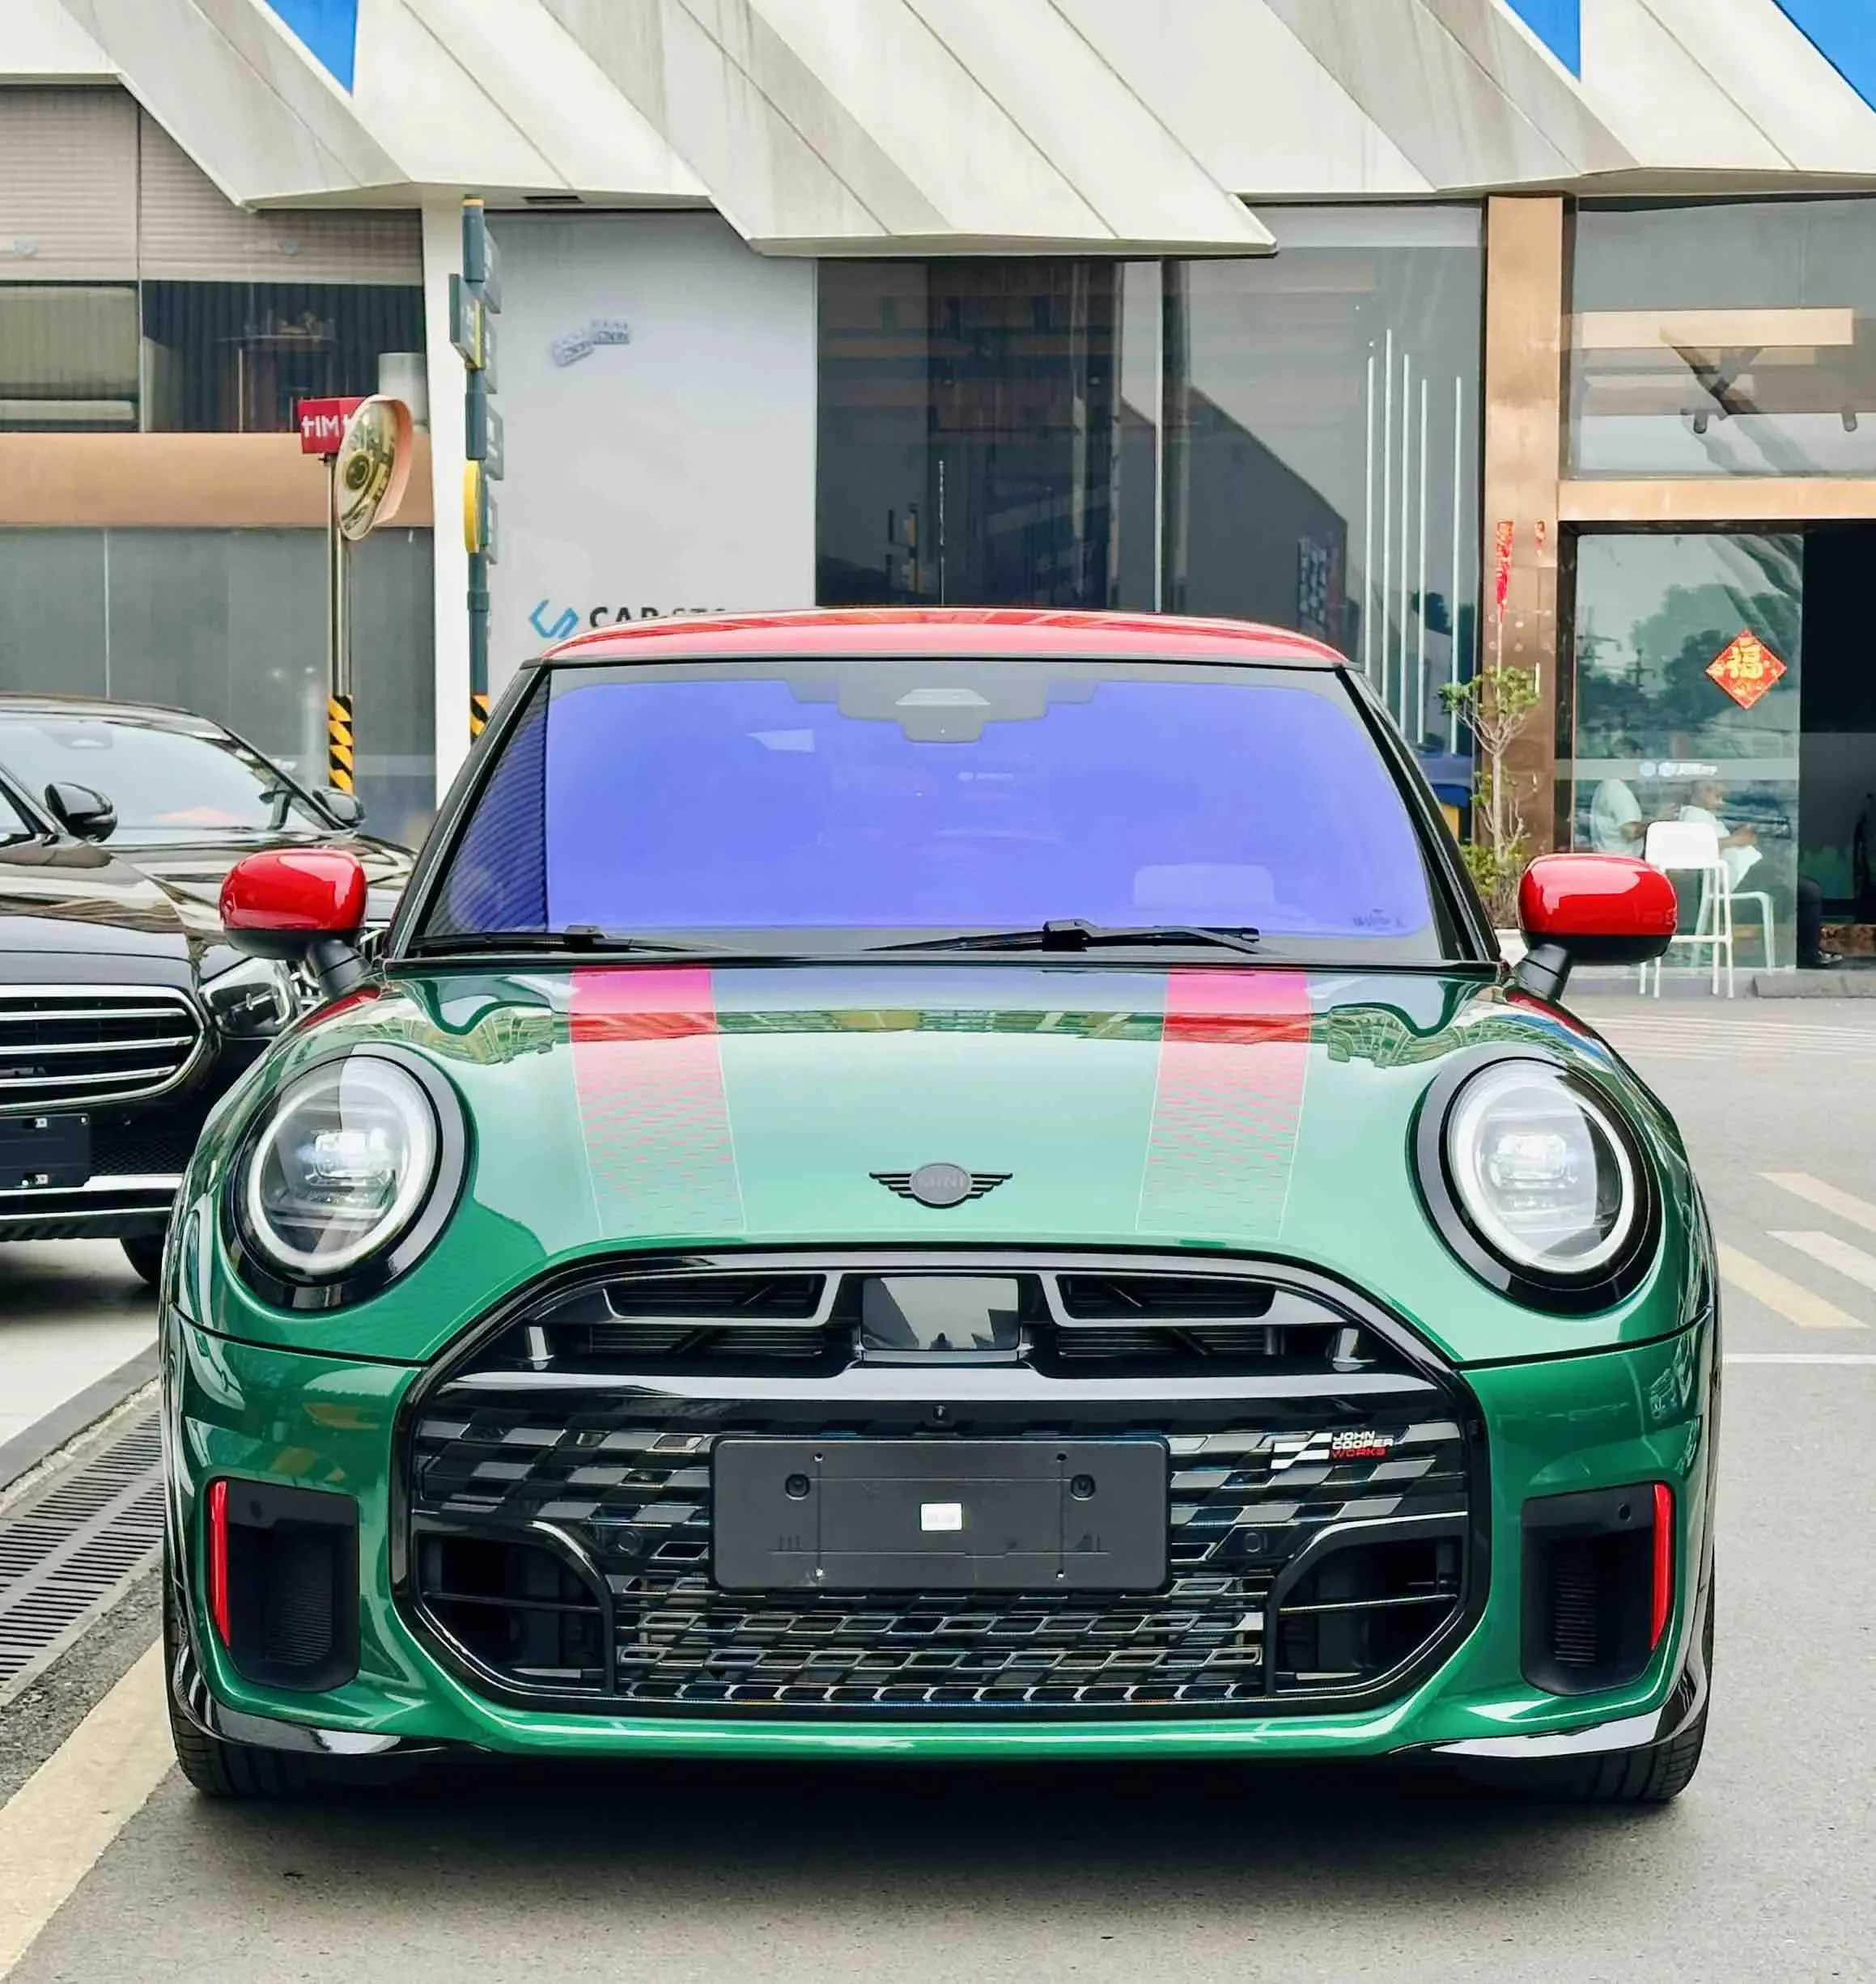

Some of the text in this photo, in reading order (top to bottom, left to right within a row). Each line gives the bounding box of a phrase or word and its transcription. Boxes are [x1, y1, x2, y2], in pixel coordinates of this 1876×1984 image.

[1726, 644, 1763, 680] 福
[915, 1175, 964, 1189] MINI
[1332, 1431, 1376, 1442] JOHN
[1331, 1438, 1394, 1450] COOPER
[1331, 1448, 1386, 1459] WORKS
